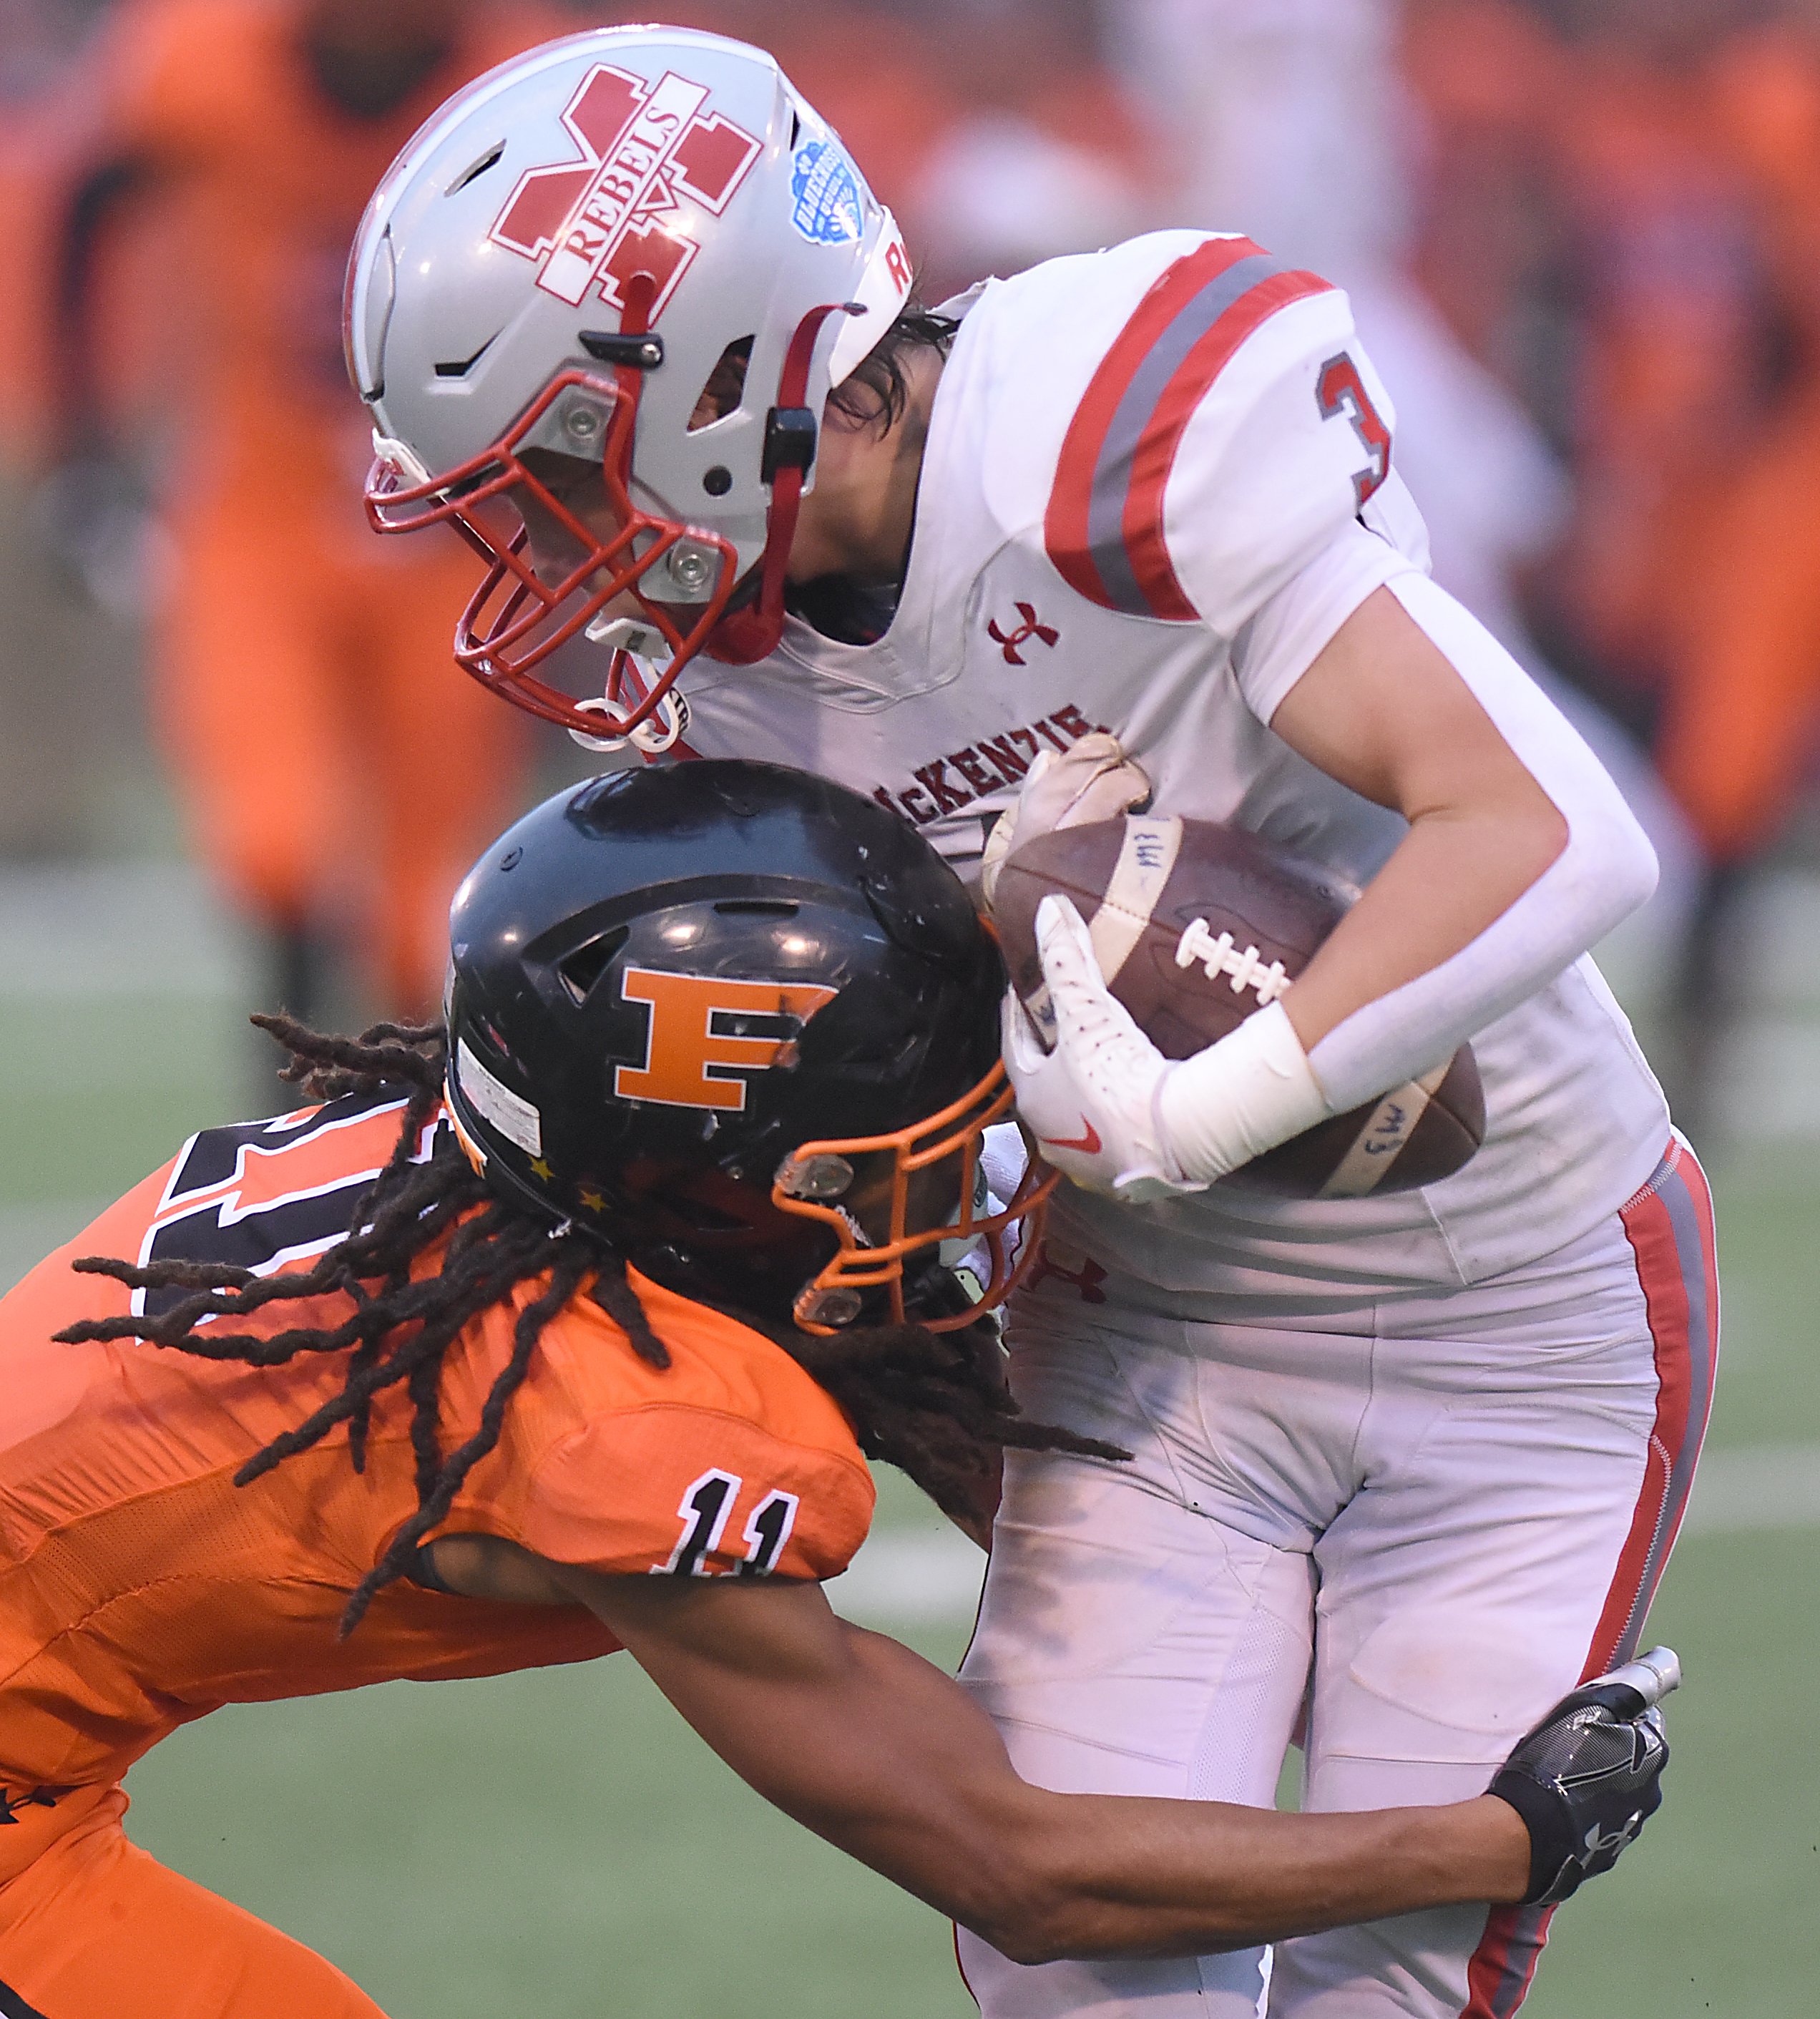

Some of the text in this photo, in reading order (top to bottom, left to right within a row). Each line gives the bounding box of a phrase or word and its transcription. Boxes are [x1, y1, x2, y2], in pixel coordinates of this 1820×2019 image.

[563, 106, 680, 267] REBELS
[1314, 350, 1394, 519] 3
[614, 967, 839, 1112] F
[649, 1467, 800, 1578] 11
